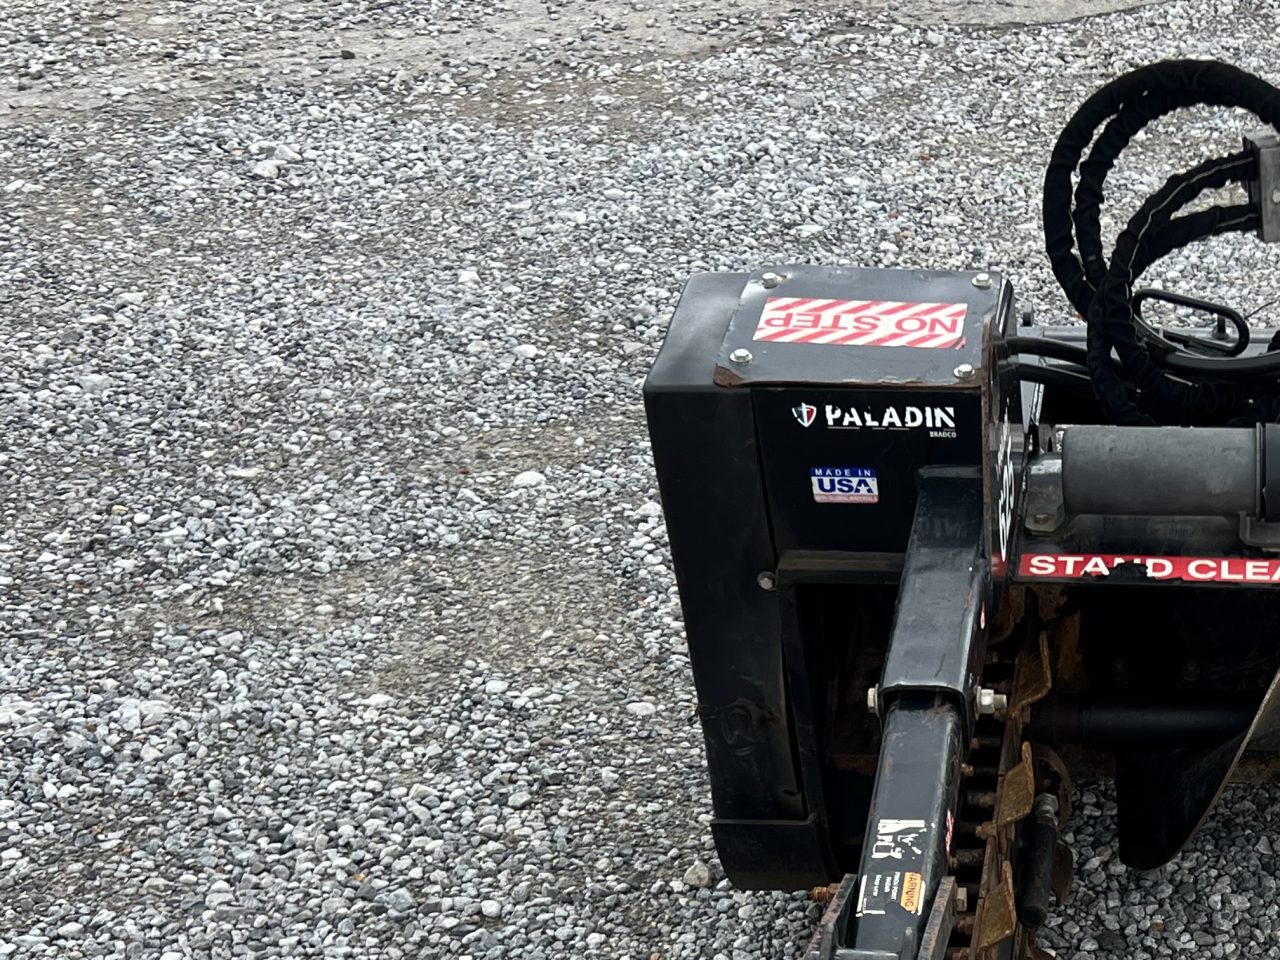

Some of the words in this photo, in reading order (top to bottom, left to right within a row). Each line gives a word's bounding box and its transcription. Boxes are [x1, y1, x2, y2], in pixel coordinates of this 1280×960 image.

[764, 312, 882, 332] STEP
[895, 316, 959, 334] NO
[825, 404, 956, 428] PALADIN
[815, 468, 851, 477] MADE
[858, 469, 871, 477] IN
[817, 478, 875, 494] USA
[1029, 555, 1173, 578] STAD
